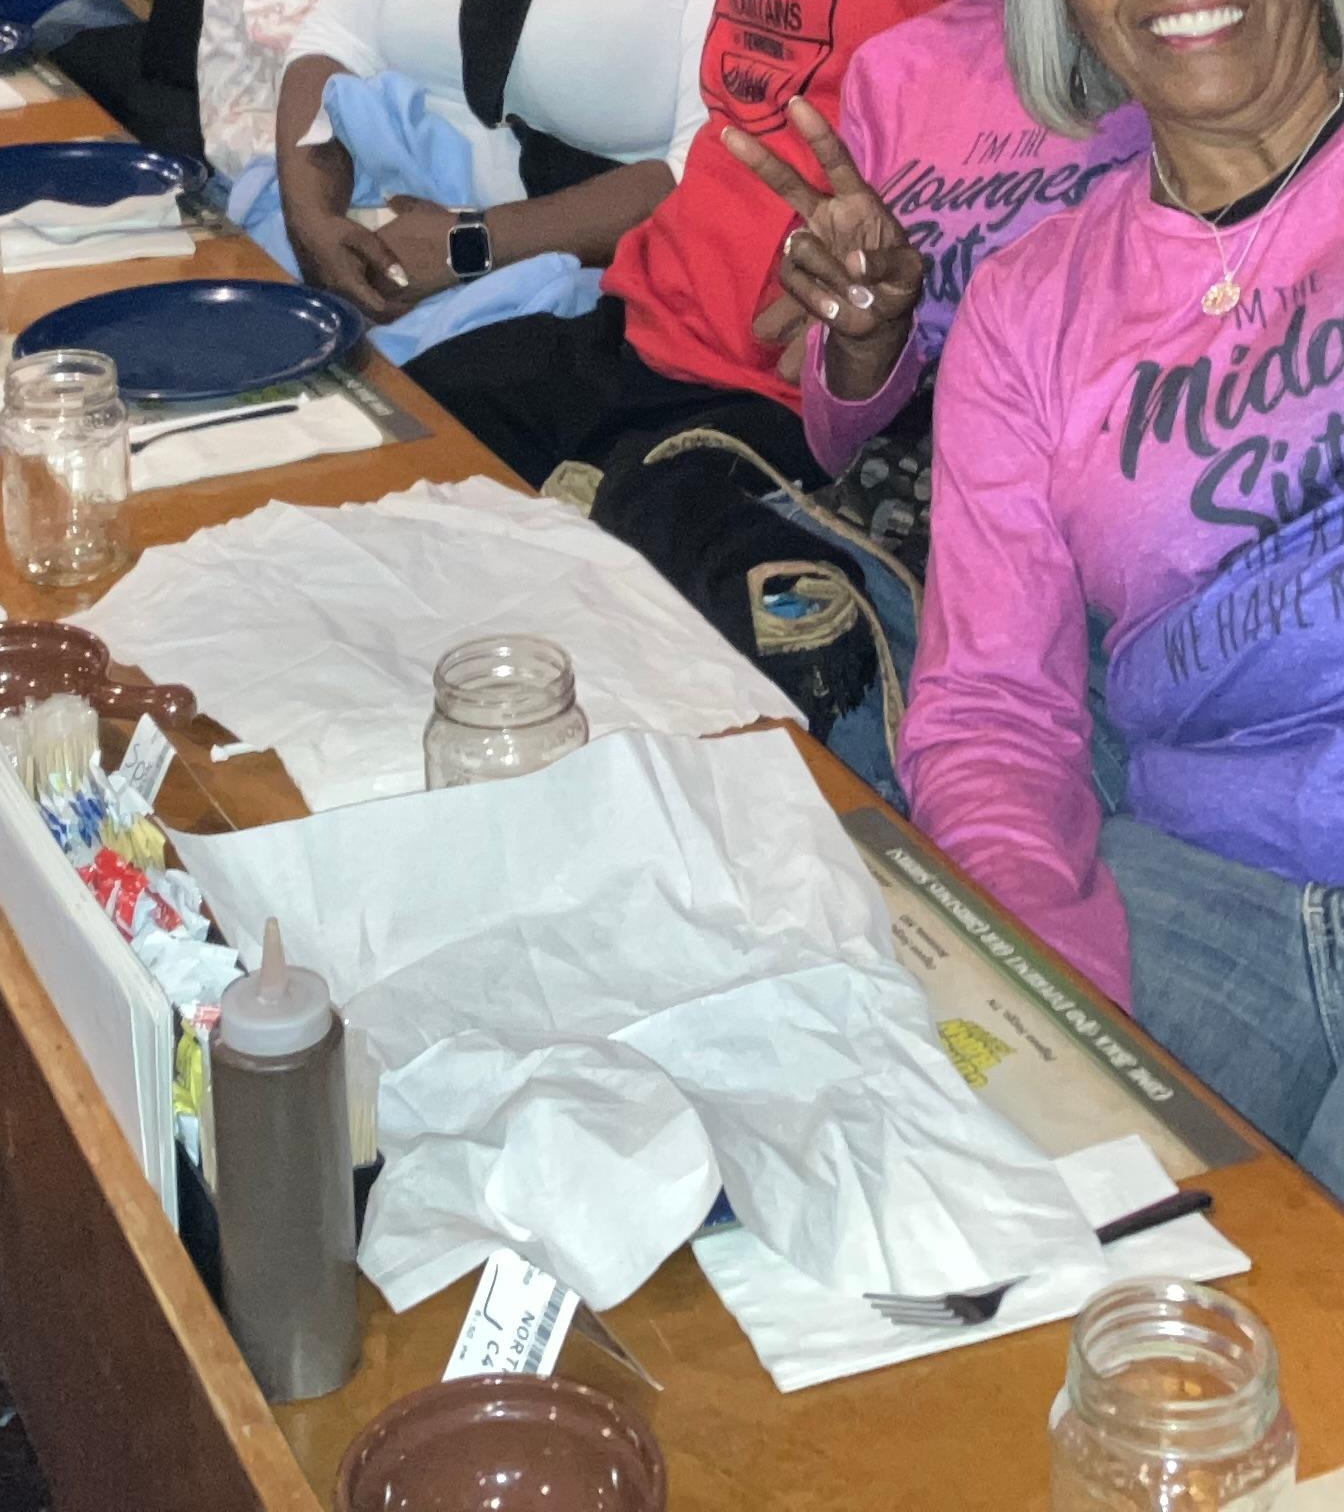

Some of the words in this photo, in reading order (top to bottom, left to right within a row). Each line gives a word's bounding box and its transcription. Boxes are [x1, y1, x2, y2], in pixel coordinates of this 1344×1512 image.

[961, 130, 1013, 166] I'M
[879, 149, 1142, 233] Younges
[1163, 601, 1209, 686] WE
[1215, 570, 1315, 662] HAVE
[502, 1310, 536, 1372] NORT
